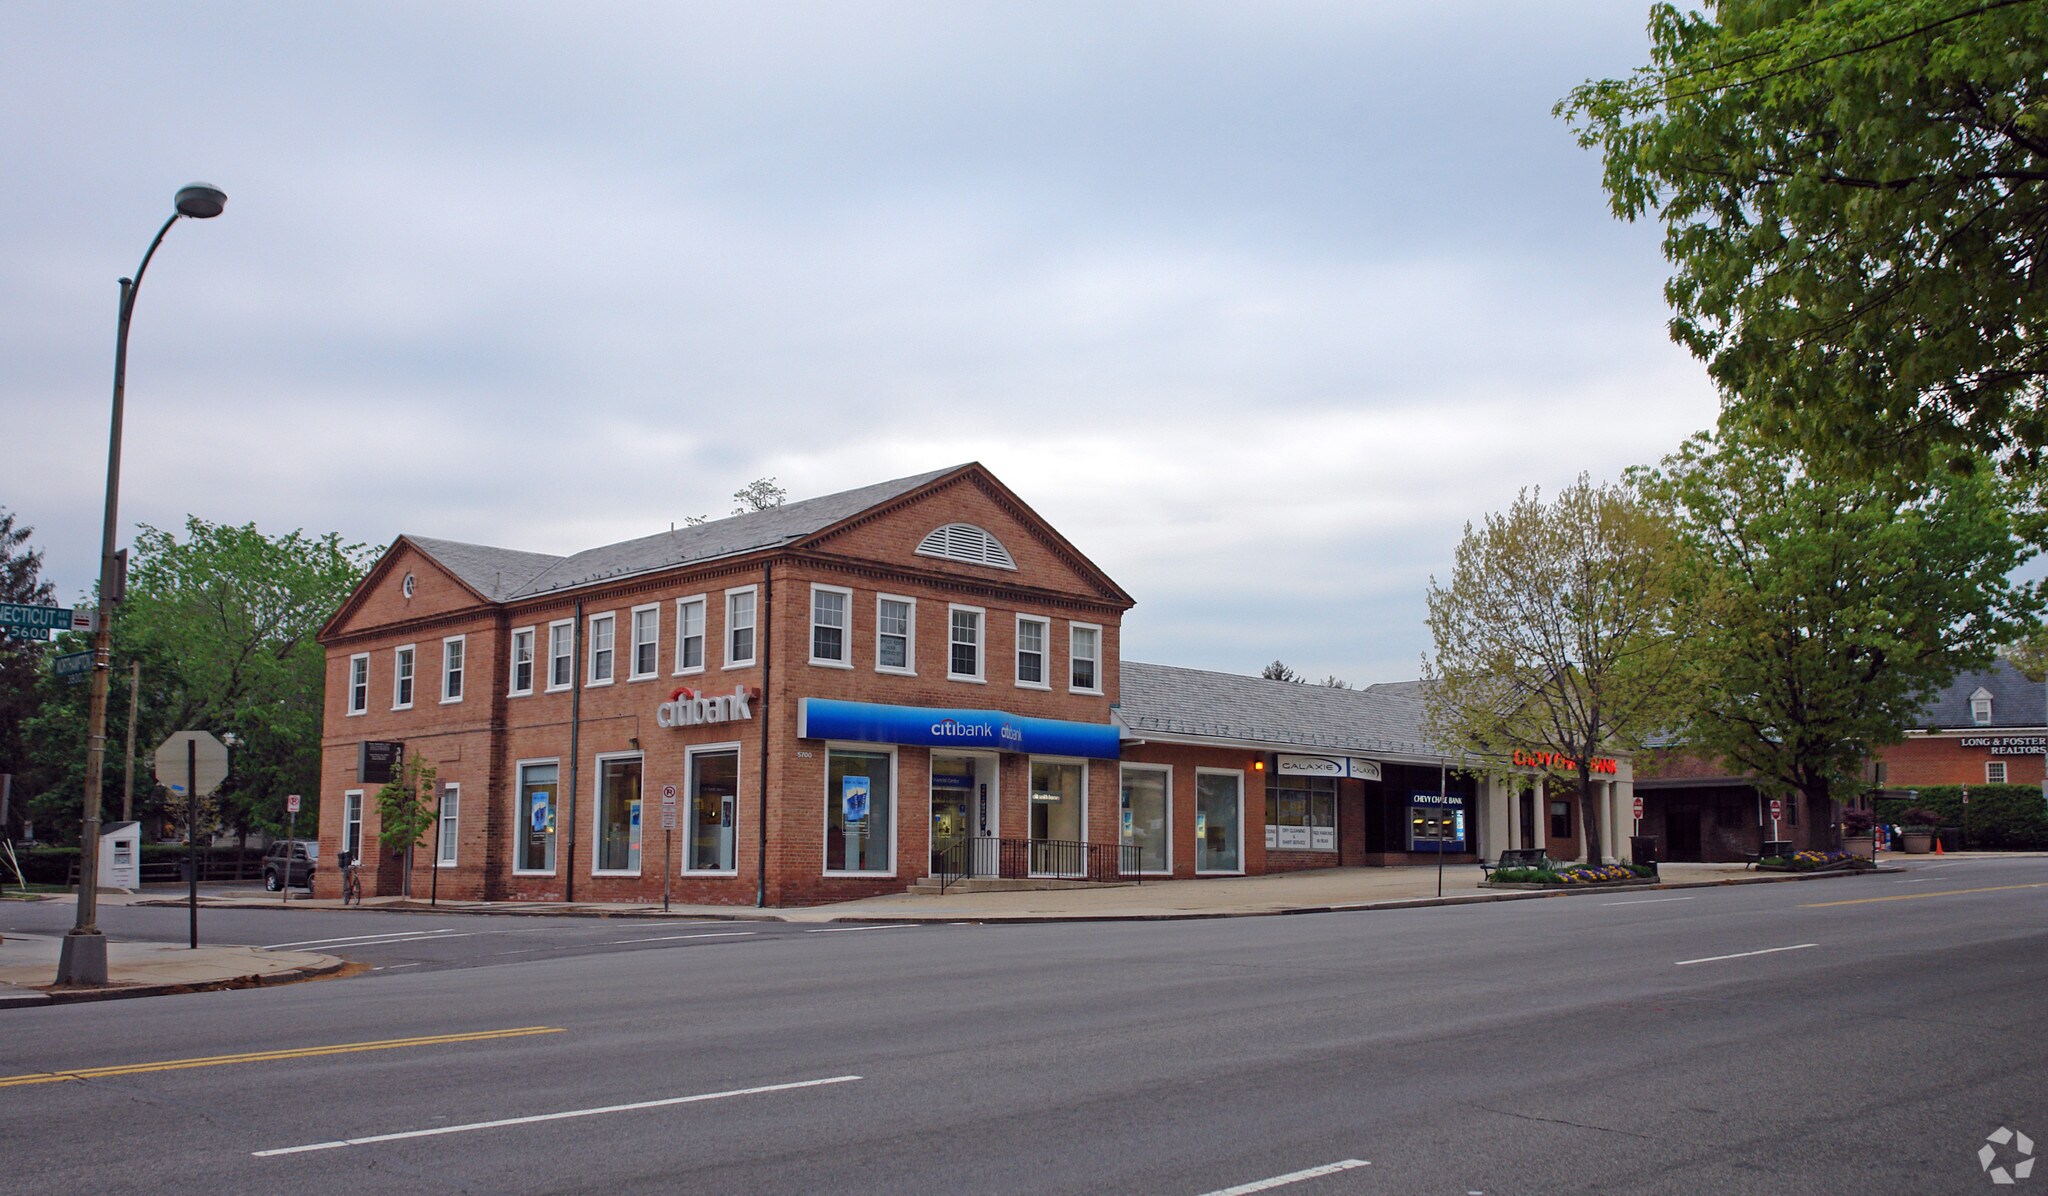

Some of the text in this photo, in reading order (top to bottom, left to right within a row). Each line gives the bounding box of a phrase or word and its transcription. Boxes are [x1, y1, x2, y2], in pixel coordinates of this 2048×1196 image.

[11, 626, 48, 639] 5600
[657, 684, 753, 728] citibank
[931, 719, 993, 737] citibank
[1001, 722, 1023, 741] citibank
[1961, 737, 2047, 746] LONG & FOSTER
[797, 751, 813, 759] 5700
[1991, 746, 2047, 755] REALTORS
[1282, 762, 1334, 771] GALAXIE
[1413, 794, 1431, 803] CHEVY
[1448, 796, 1463, 805] BANK
